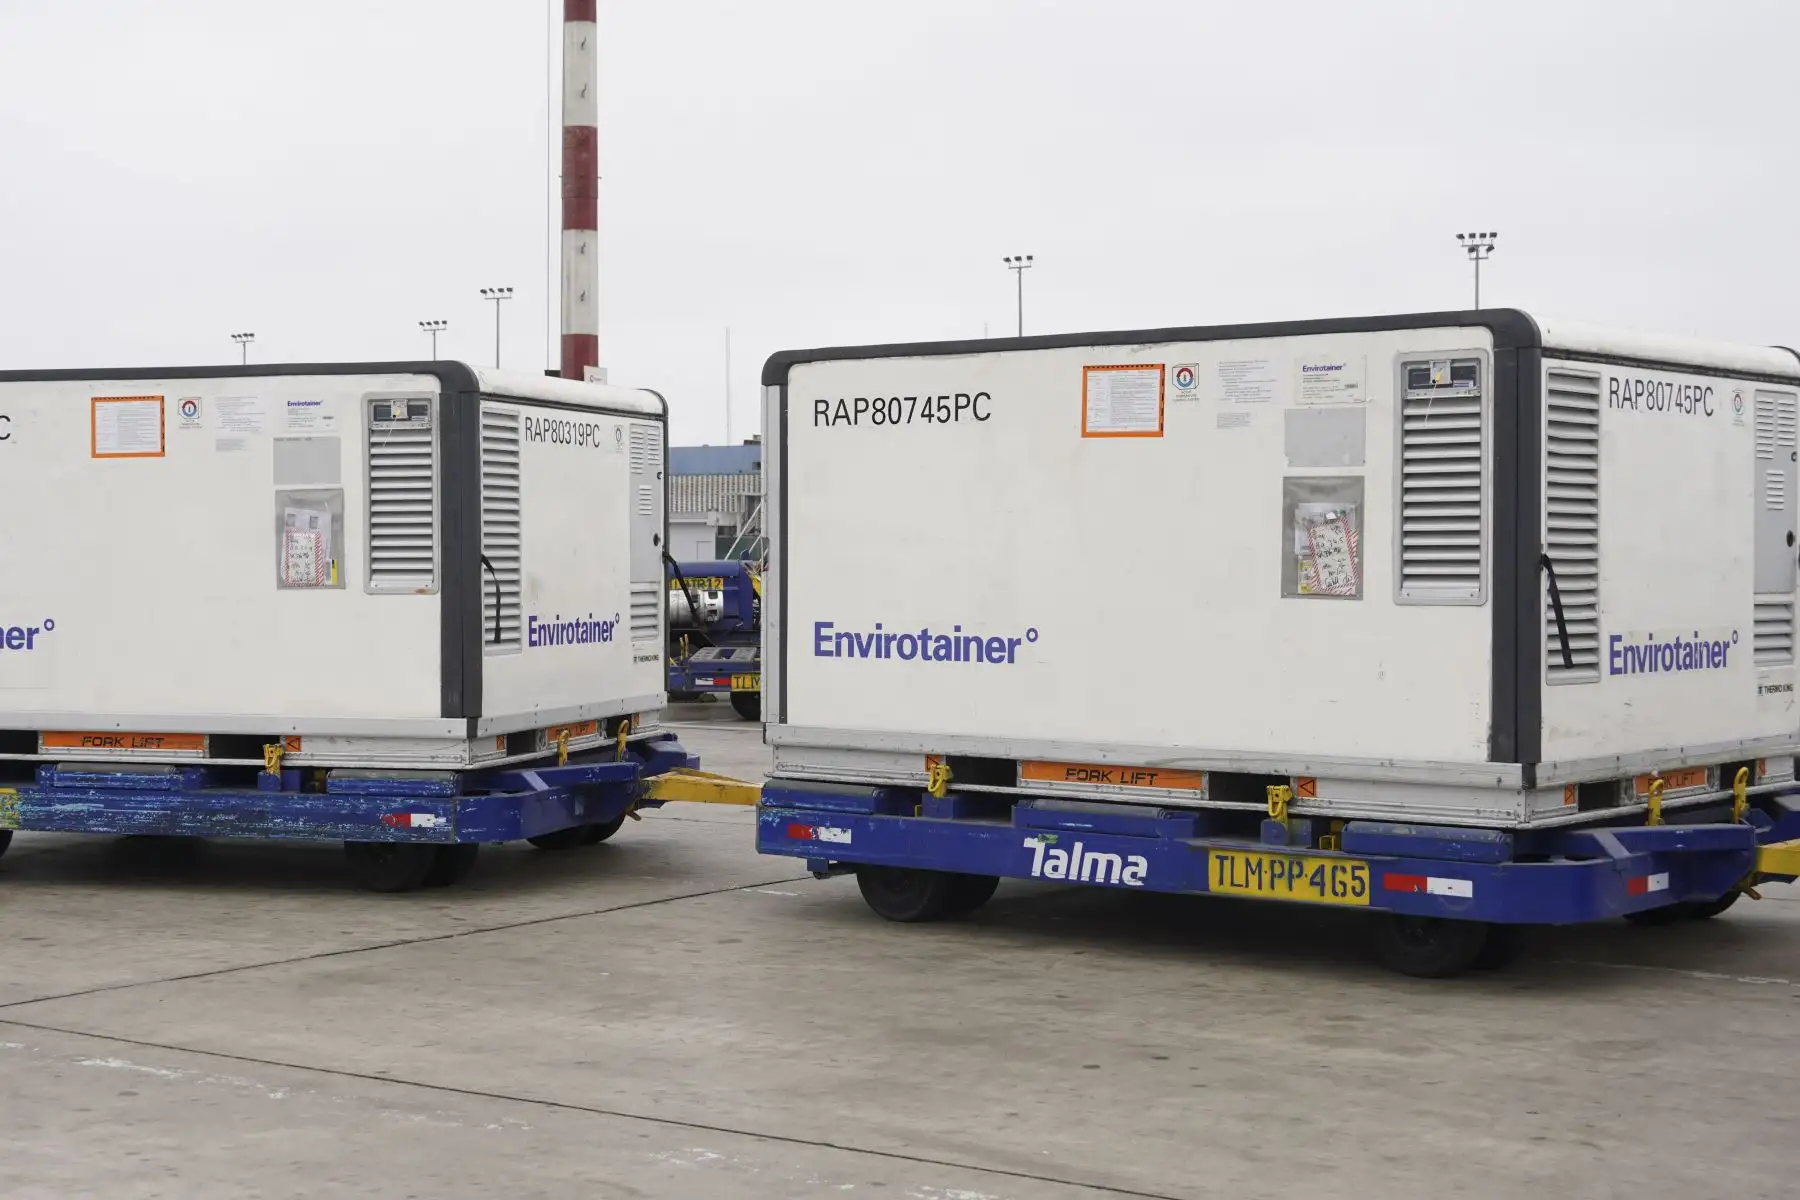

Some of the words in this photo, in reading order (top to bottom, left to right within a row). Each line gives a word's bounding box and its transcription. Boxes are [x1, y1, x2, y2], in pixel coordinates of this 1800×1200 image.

[813, 391, 992, 427] RAP80745PC
[1609, 377, 1714, 417] RAP80745PC
[524, 416, 600, 448] RAP80319PC
[82, 736, 125, 748] FORK
[131, 737, 165, 748] LIFT
[1065, 767, 1114, 783] FORK
[1120, 771, 1158, 786] LIFT
[1676, 771, 1695, 787] LIFT
[1023, 836, 1149, 887] Talma
